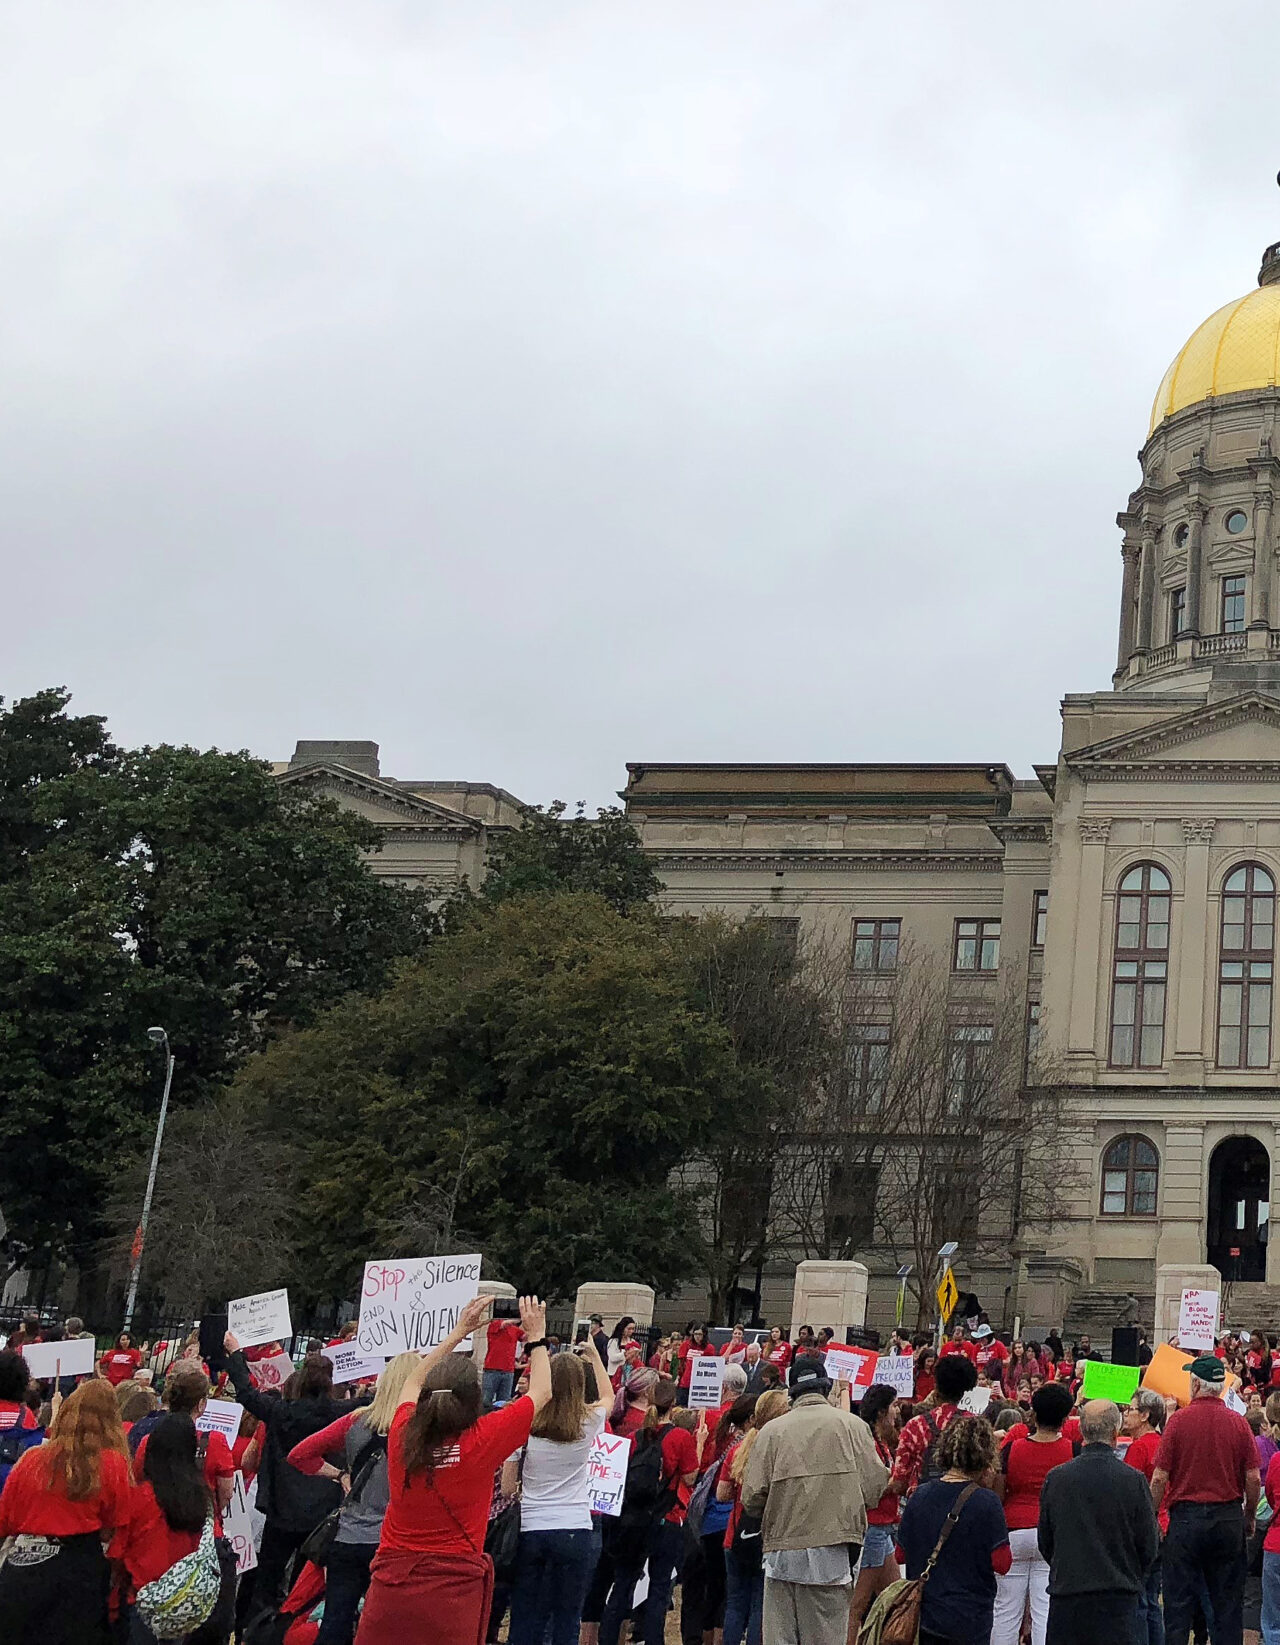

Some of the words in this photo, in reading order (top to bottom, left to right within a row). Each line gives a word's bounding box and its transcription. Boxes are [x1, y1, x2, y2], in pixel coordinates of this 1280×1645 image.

[364, 1265, 405, 1302] Stop
[408, 1269, 423, 1285] the
[423, 1260, 479, 1290] Silence
[362, 1304, 385, 1323] END
[358, 1309, 398, 1352] GUN
[402, 1305, 471, 1351] VIOLEN
[336, 1356, 356, 1365] DEMA
[337, 1360, 363, 1370] ACTION
[875, 1371, 912, 1382] PRECIOUS
